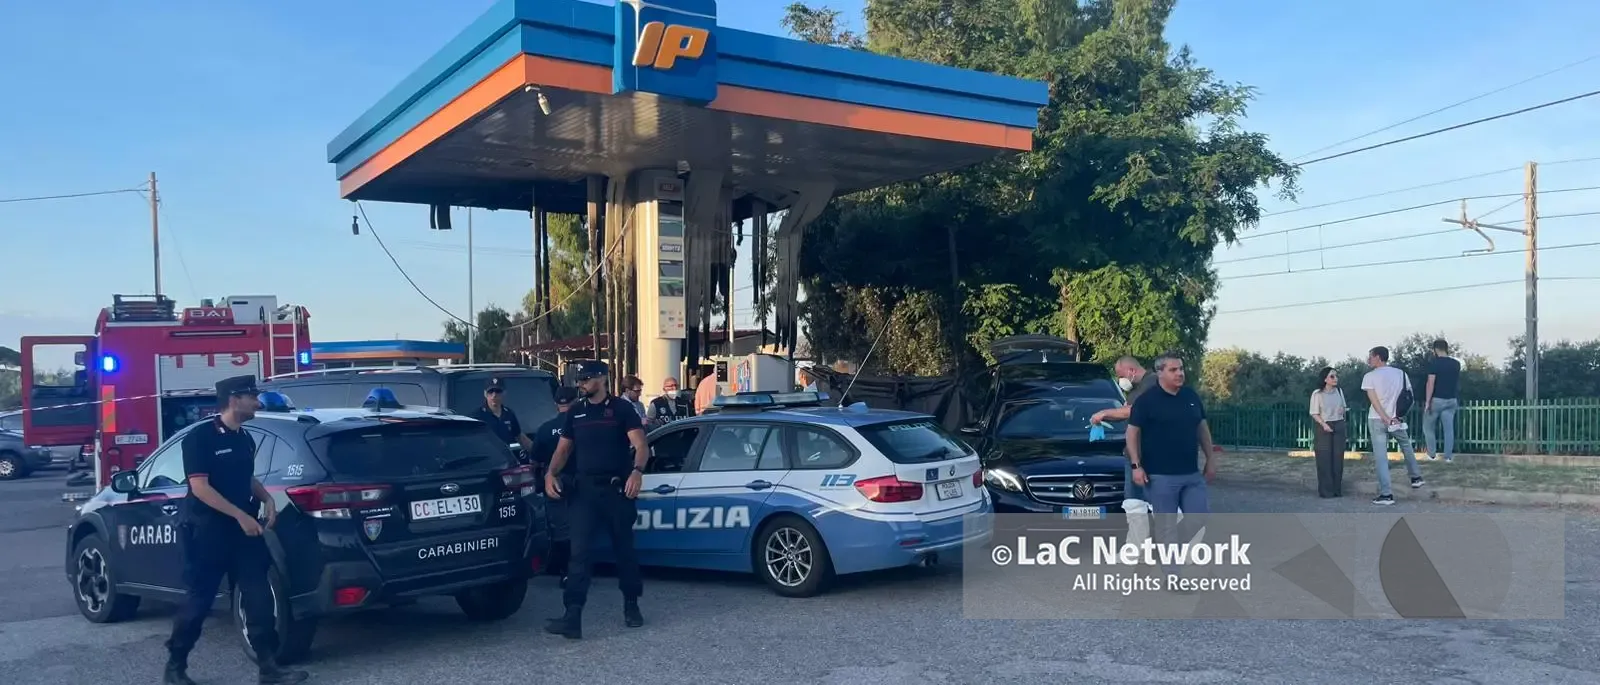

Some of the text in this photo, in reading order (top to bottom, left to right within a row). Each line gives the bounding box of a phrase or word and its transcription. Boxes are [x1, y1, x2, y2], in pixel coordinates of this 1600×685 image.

[632, 21, 709, 69] IP
[287, 464, 304, 477] 1515
[820, 474, 857, 487] 113
[499, 505, 516, 519] 1515
[418, 537, 499, 560] CARABINIERI
